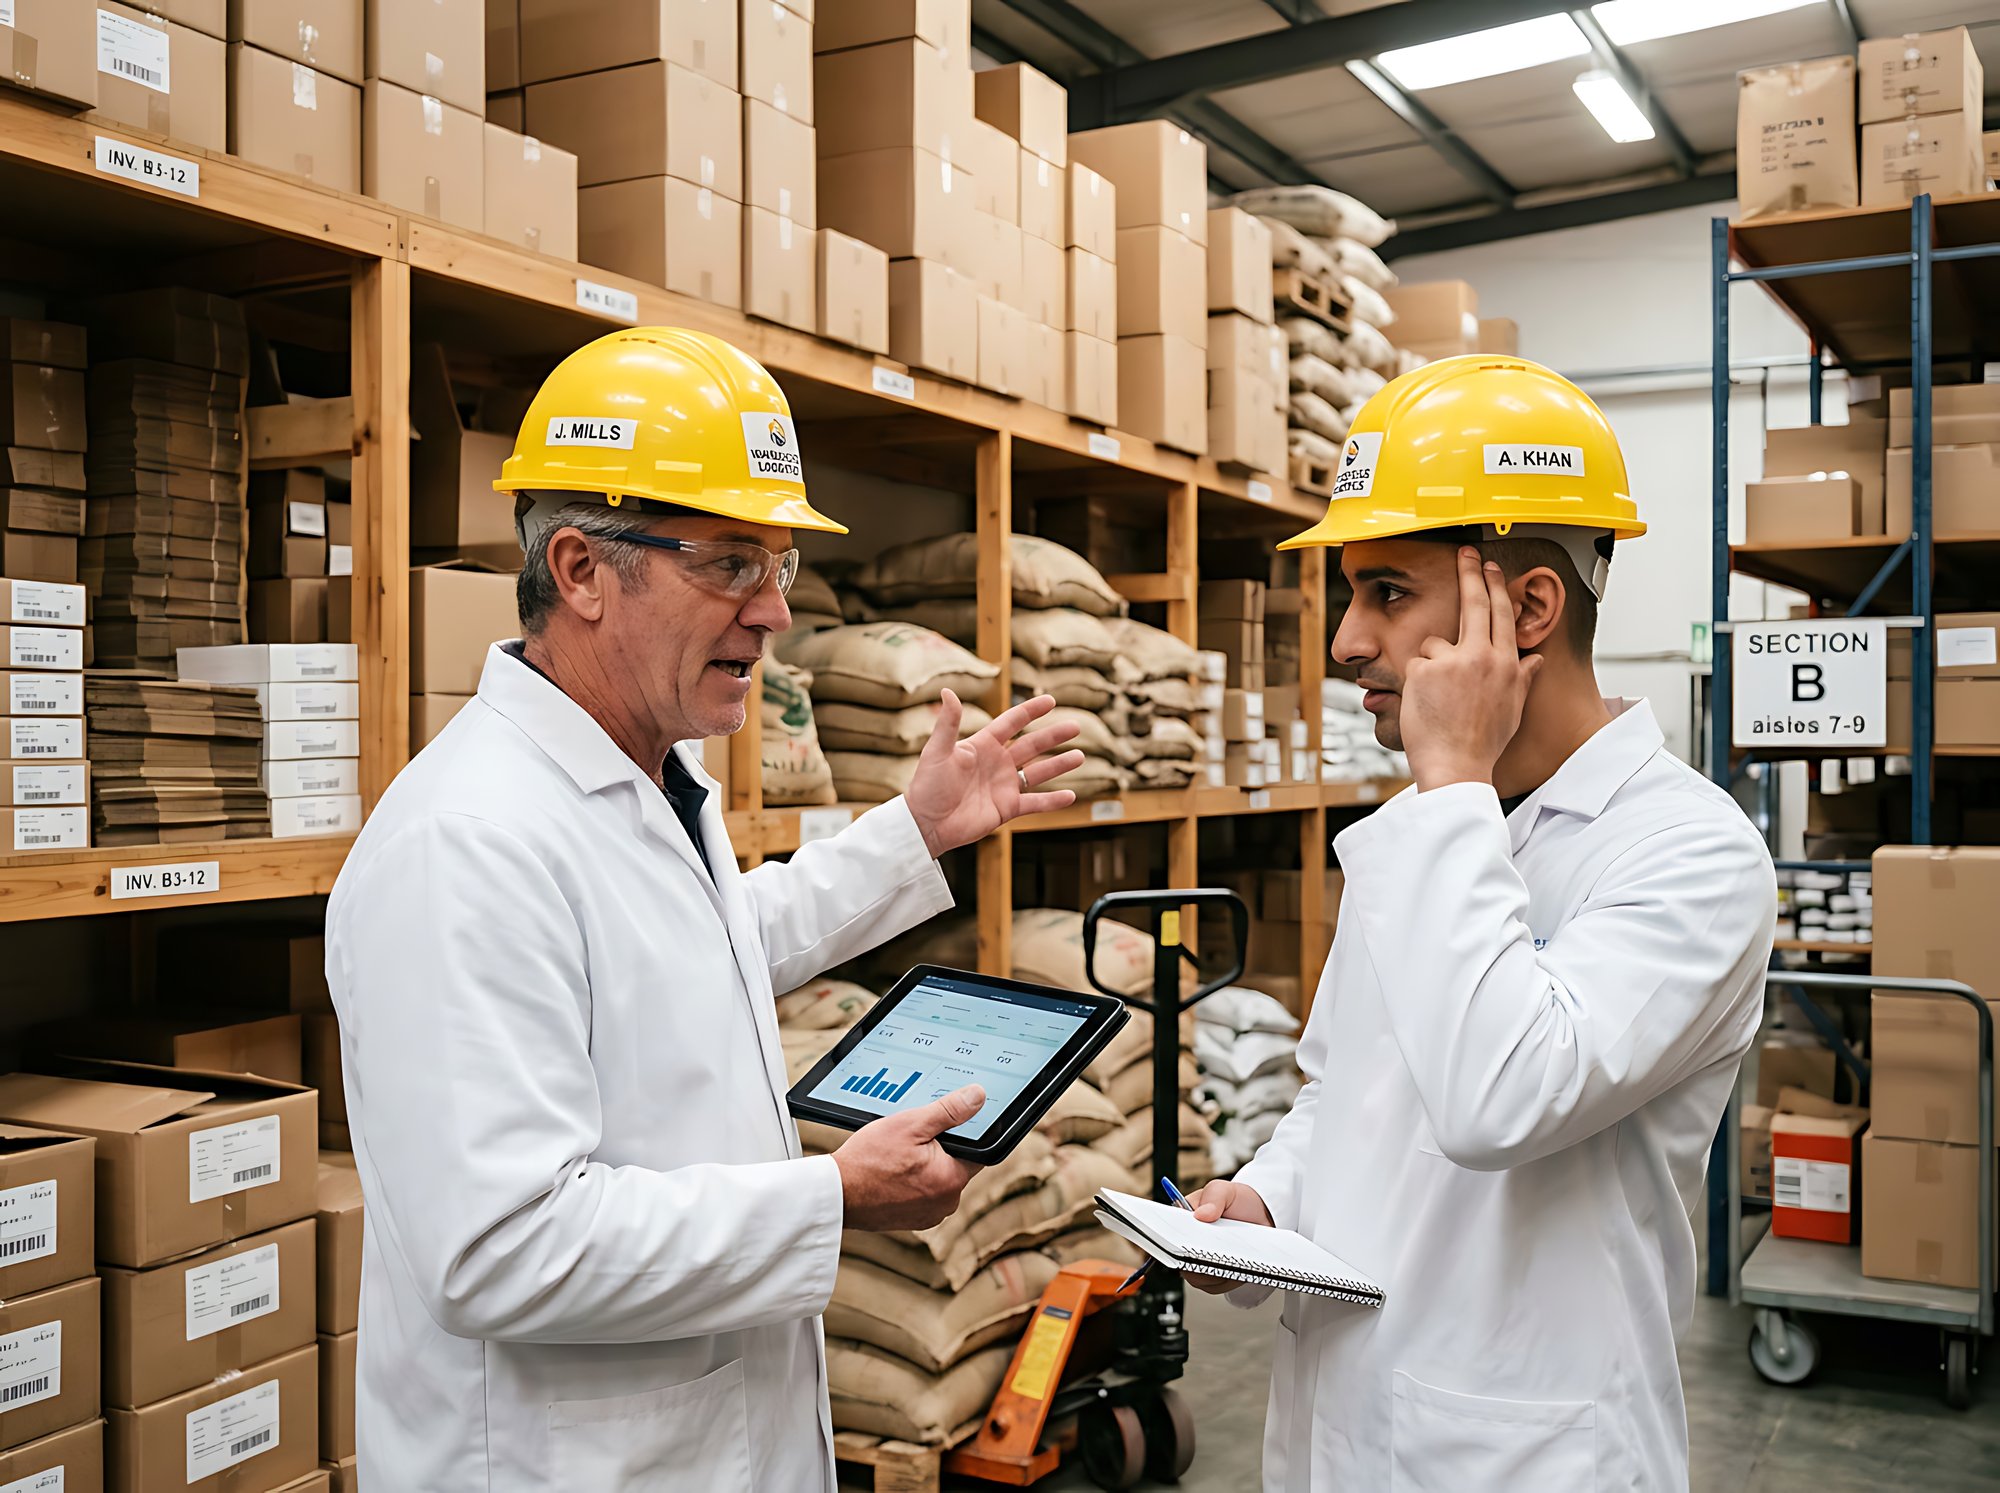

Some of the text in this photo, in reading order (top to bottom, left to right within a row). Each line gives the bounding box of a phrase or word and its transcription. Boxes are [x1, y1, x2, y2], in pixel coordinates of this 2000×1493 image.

[109, 149, 137, 171] INV.
[555, 423, 621, 441] J. MILLS
[1498, 450, 1572, 468] A. KHAN
[1749, 632, 1868, 655] SECTION
[1792, 664, 1825, 702] B
[1829, 715, 1866, 734] 7-9
[126, 870, 205, 890] INV. B3-12
